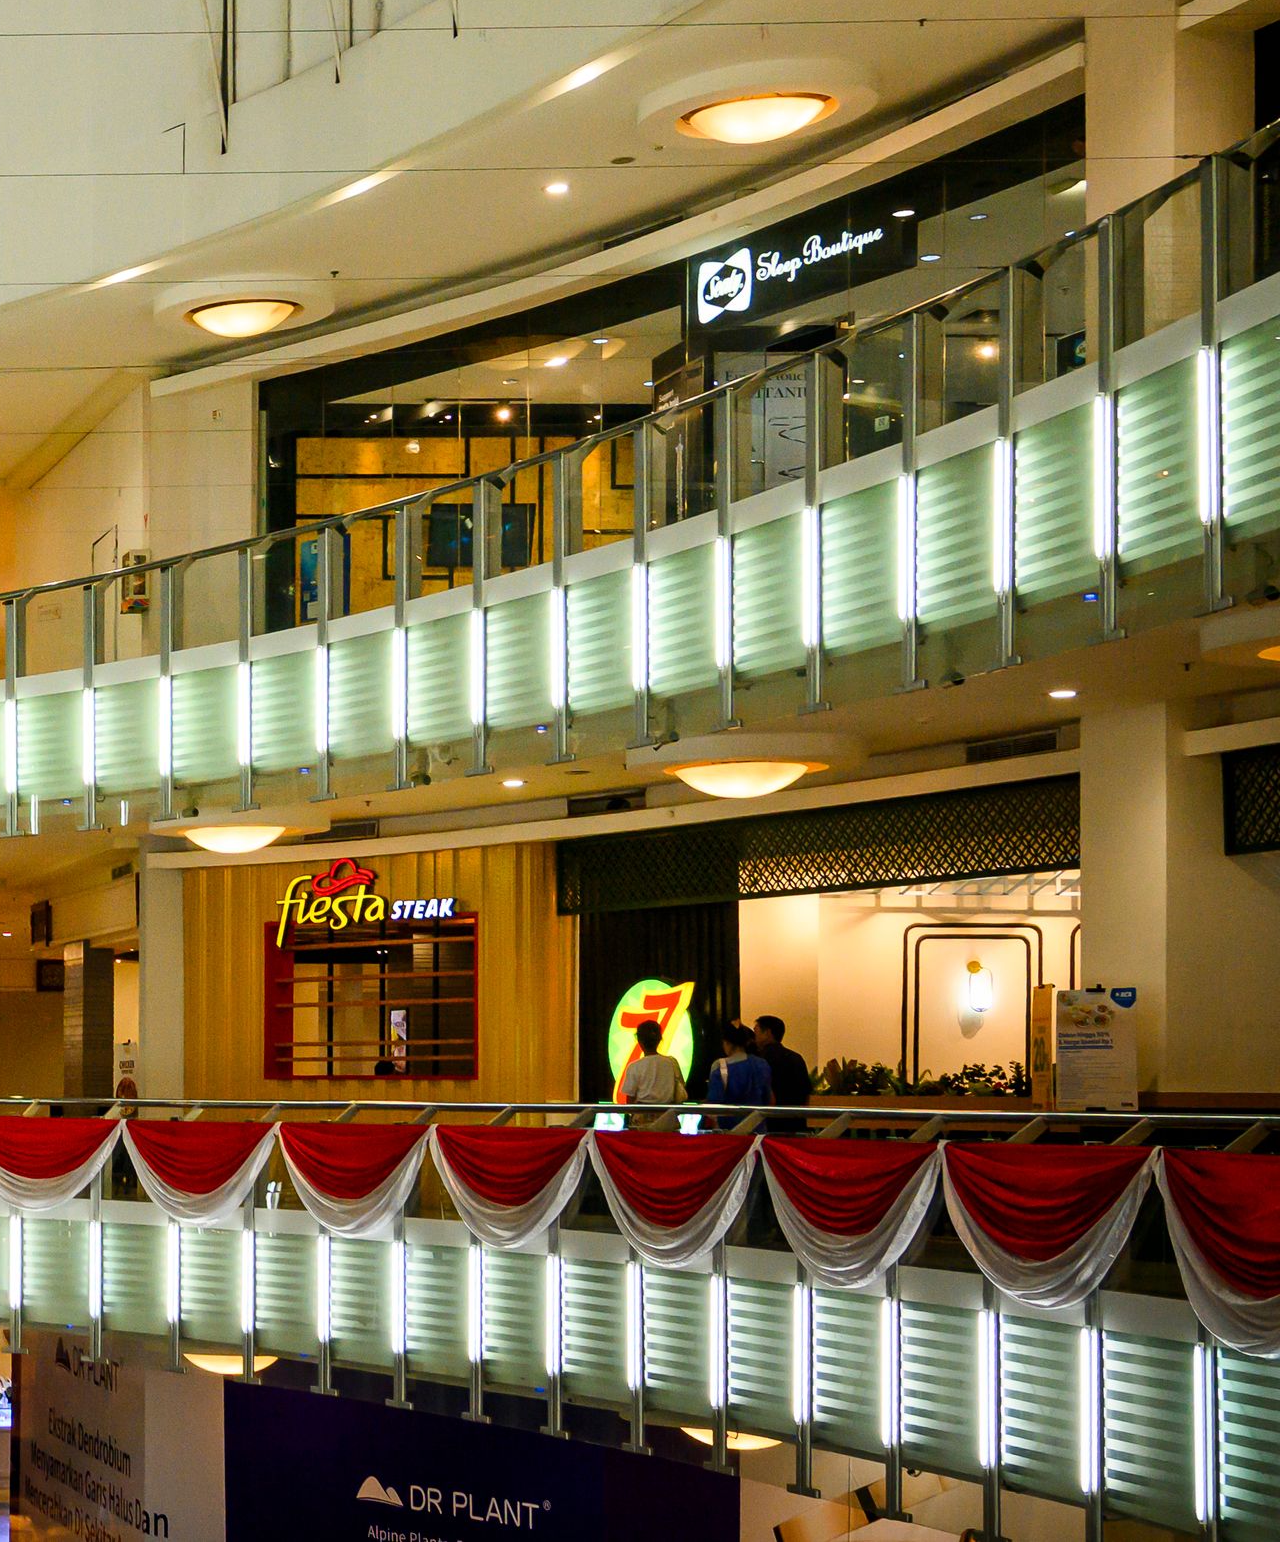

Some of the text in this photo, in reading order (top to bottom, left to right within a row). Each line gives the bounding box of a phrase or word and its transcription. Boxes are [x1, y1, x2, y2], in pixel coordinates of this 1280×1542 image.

[756, 228, 884, 282] Sleep Boutique
[276, 875, 454, 949] fiesta STEAK
[48, 1407, 132, 1478] Ekstrak Dendrobium
[30, 1439, 169, 1539] Menyamarkan Garis Halus Dan
[410, 1485, 443, 1515] DR
[368, 1525, 406, 1542] Alpine
